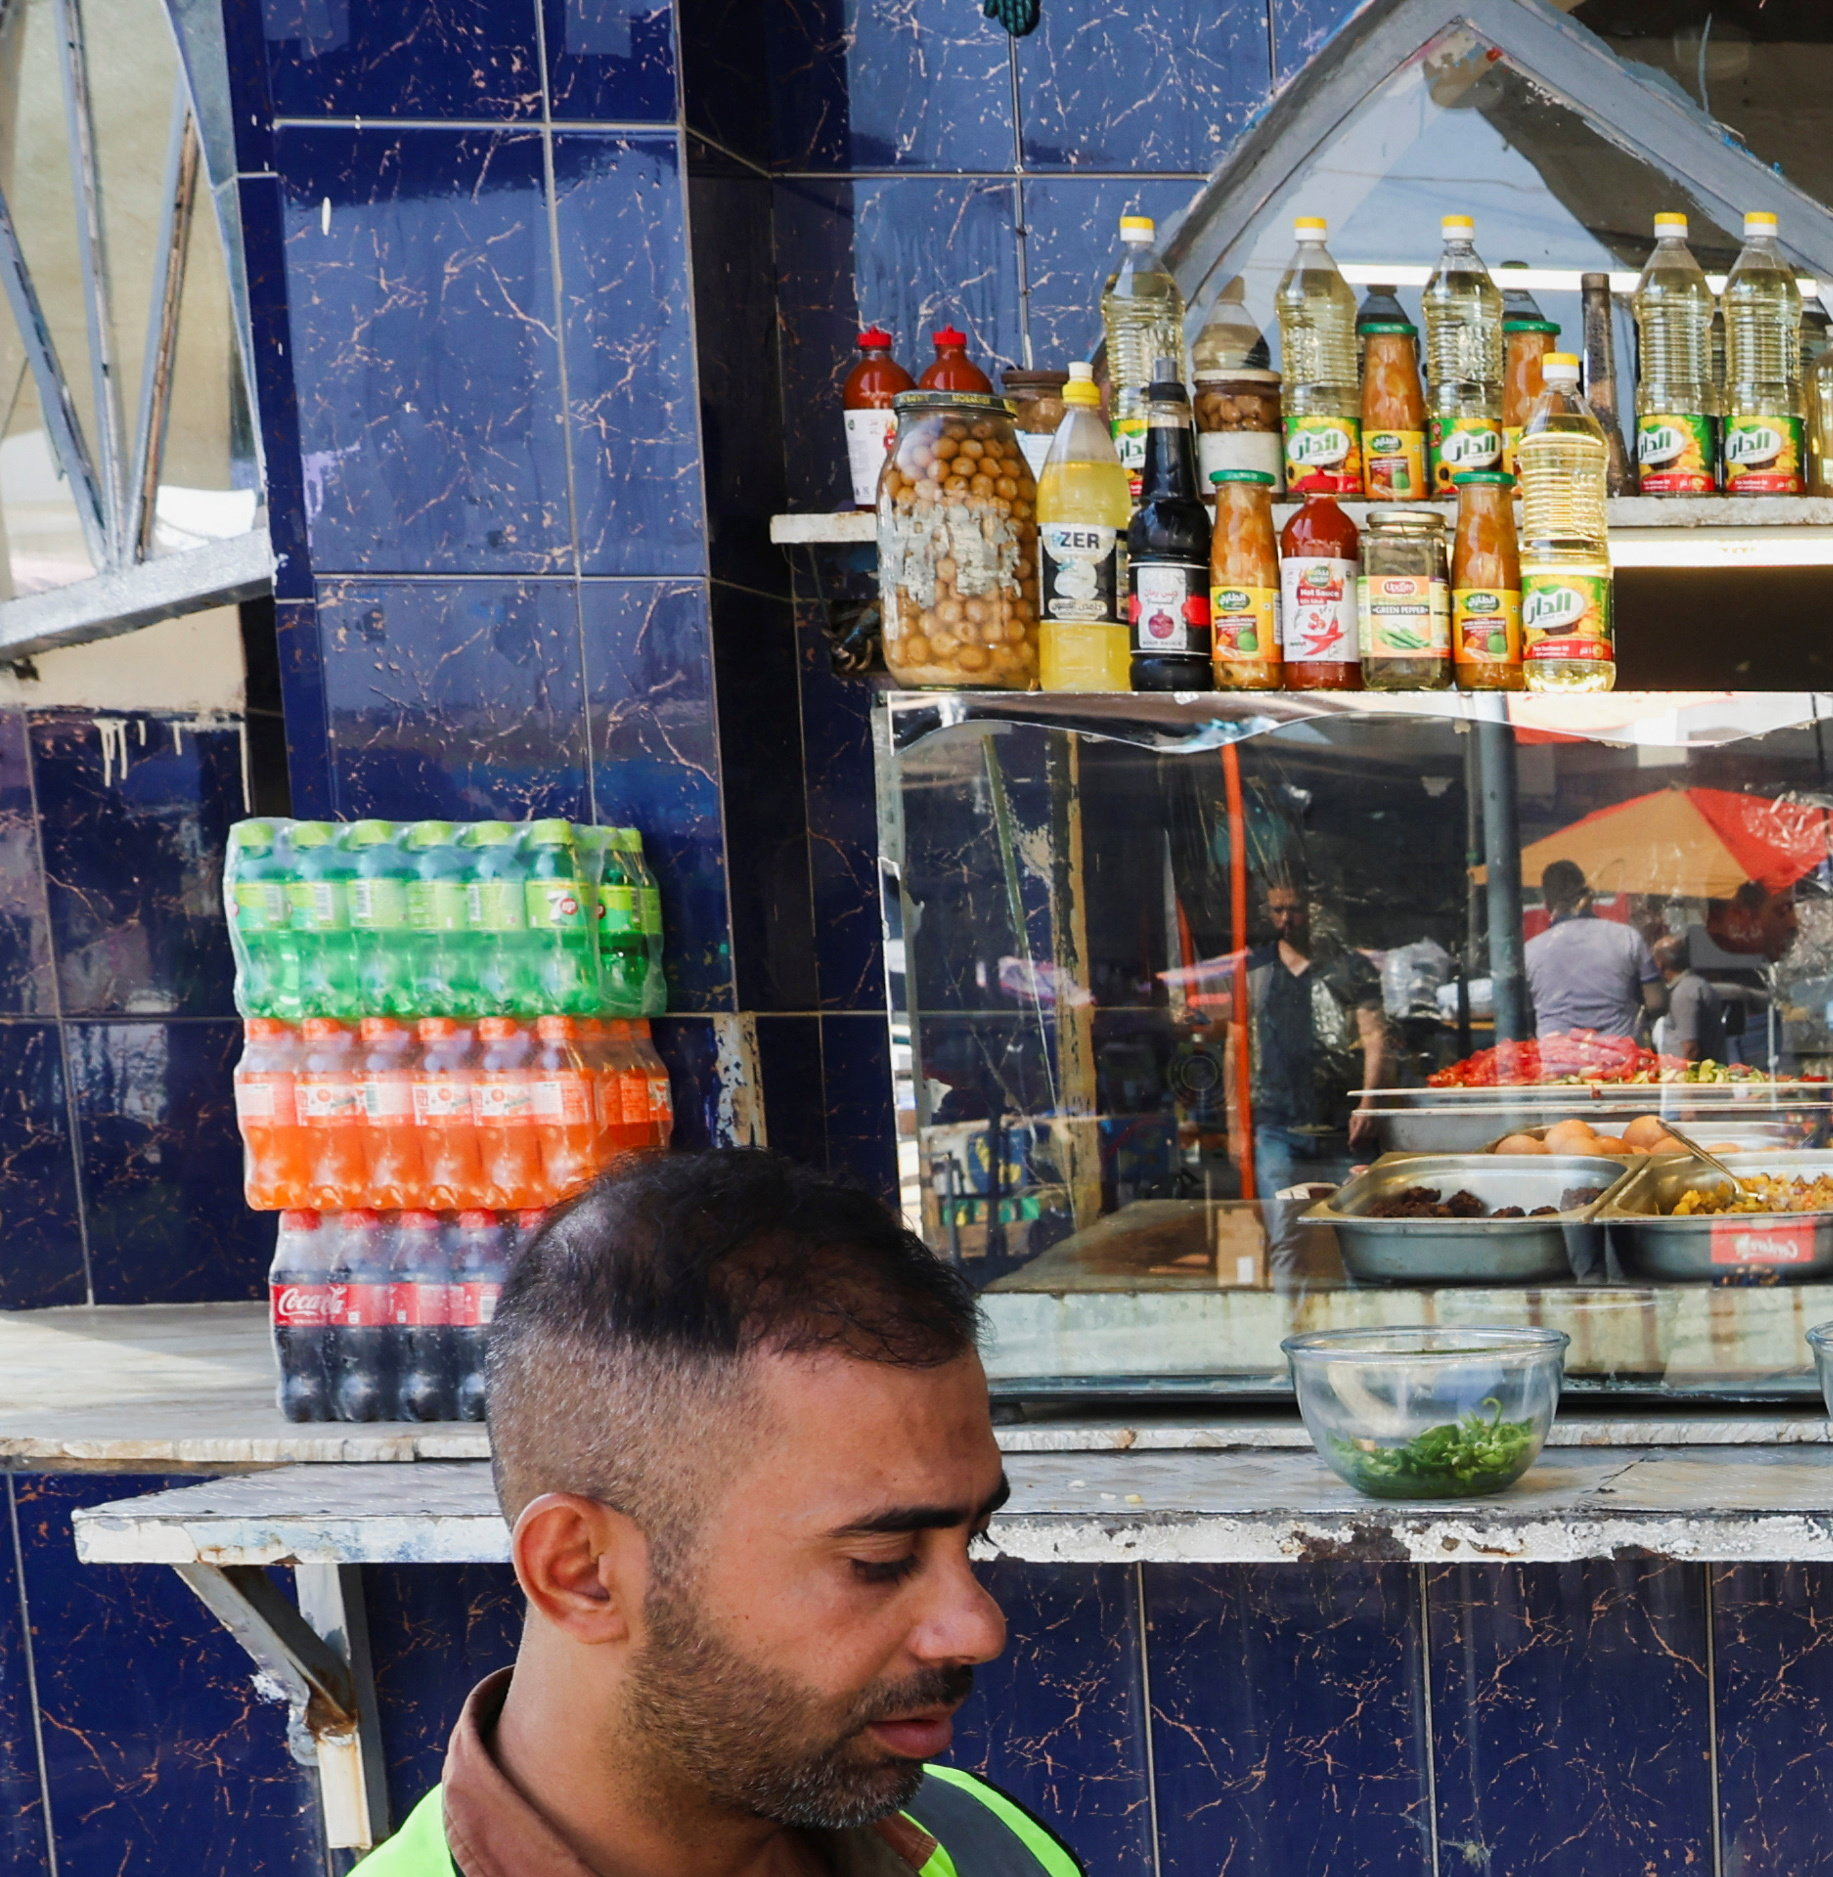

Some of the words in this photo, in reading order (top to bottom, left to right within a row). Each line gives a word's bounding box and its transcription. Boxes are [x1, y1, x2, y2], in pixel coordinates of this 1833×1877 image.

[1300, 588, 1316, 598] Hot
[1317, 589, 1340, 599] Sauce
[1375, 605, 1401, 614] GREEN
[1401, 605, 1426, 614] PEPPER
